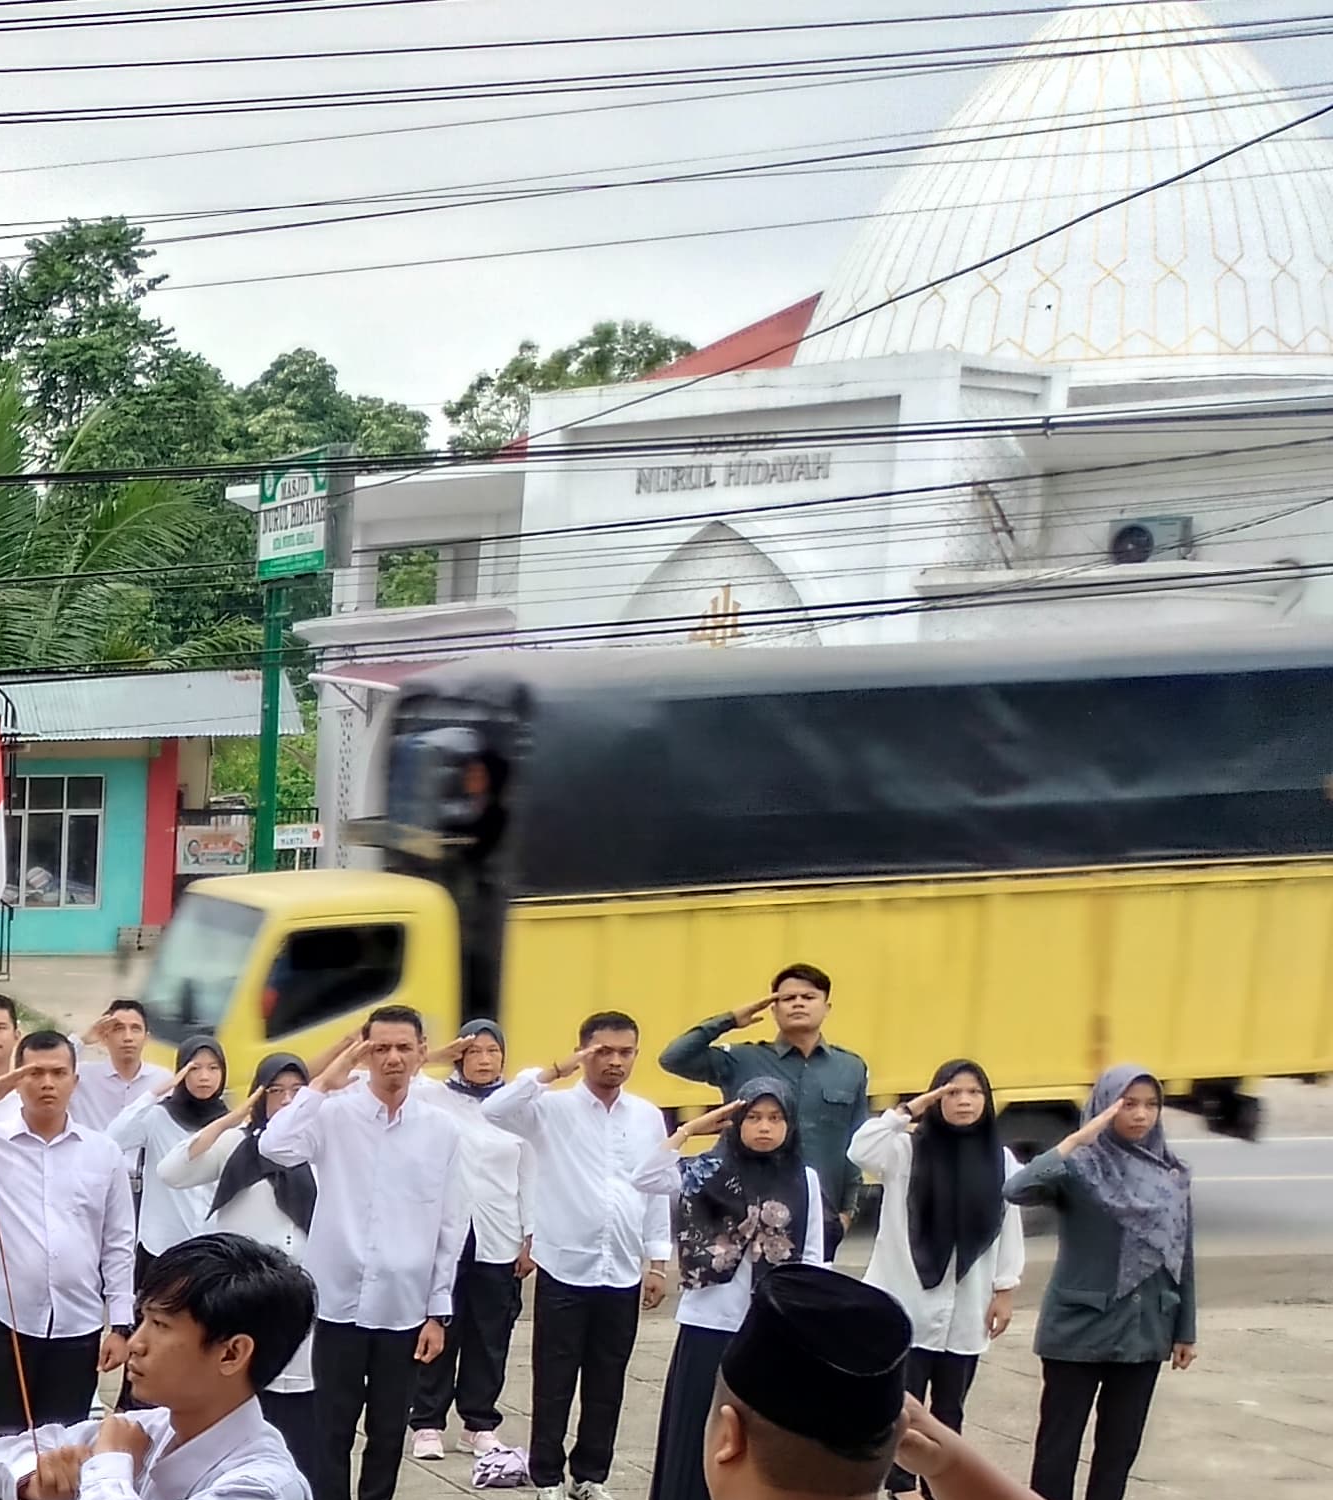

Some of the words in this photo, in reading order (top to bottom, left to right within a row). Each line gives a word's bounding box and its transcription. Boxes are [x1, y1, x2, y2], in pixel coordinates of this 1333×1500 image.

[280, 475, 309, 500] MASJID
[635, 463, 716, 494] NURUL
[723, 452, 831, 487] HIDAYAH
